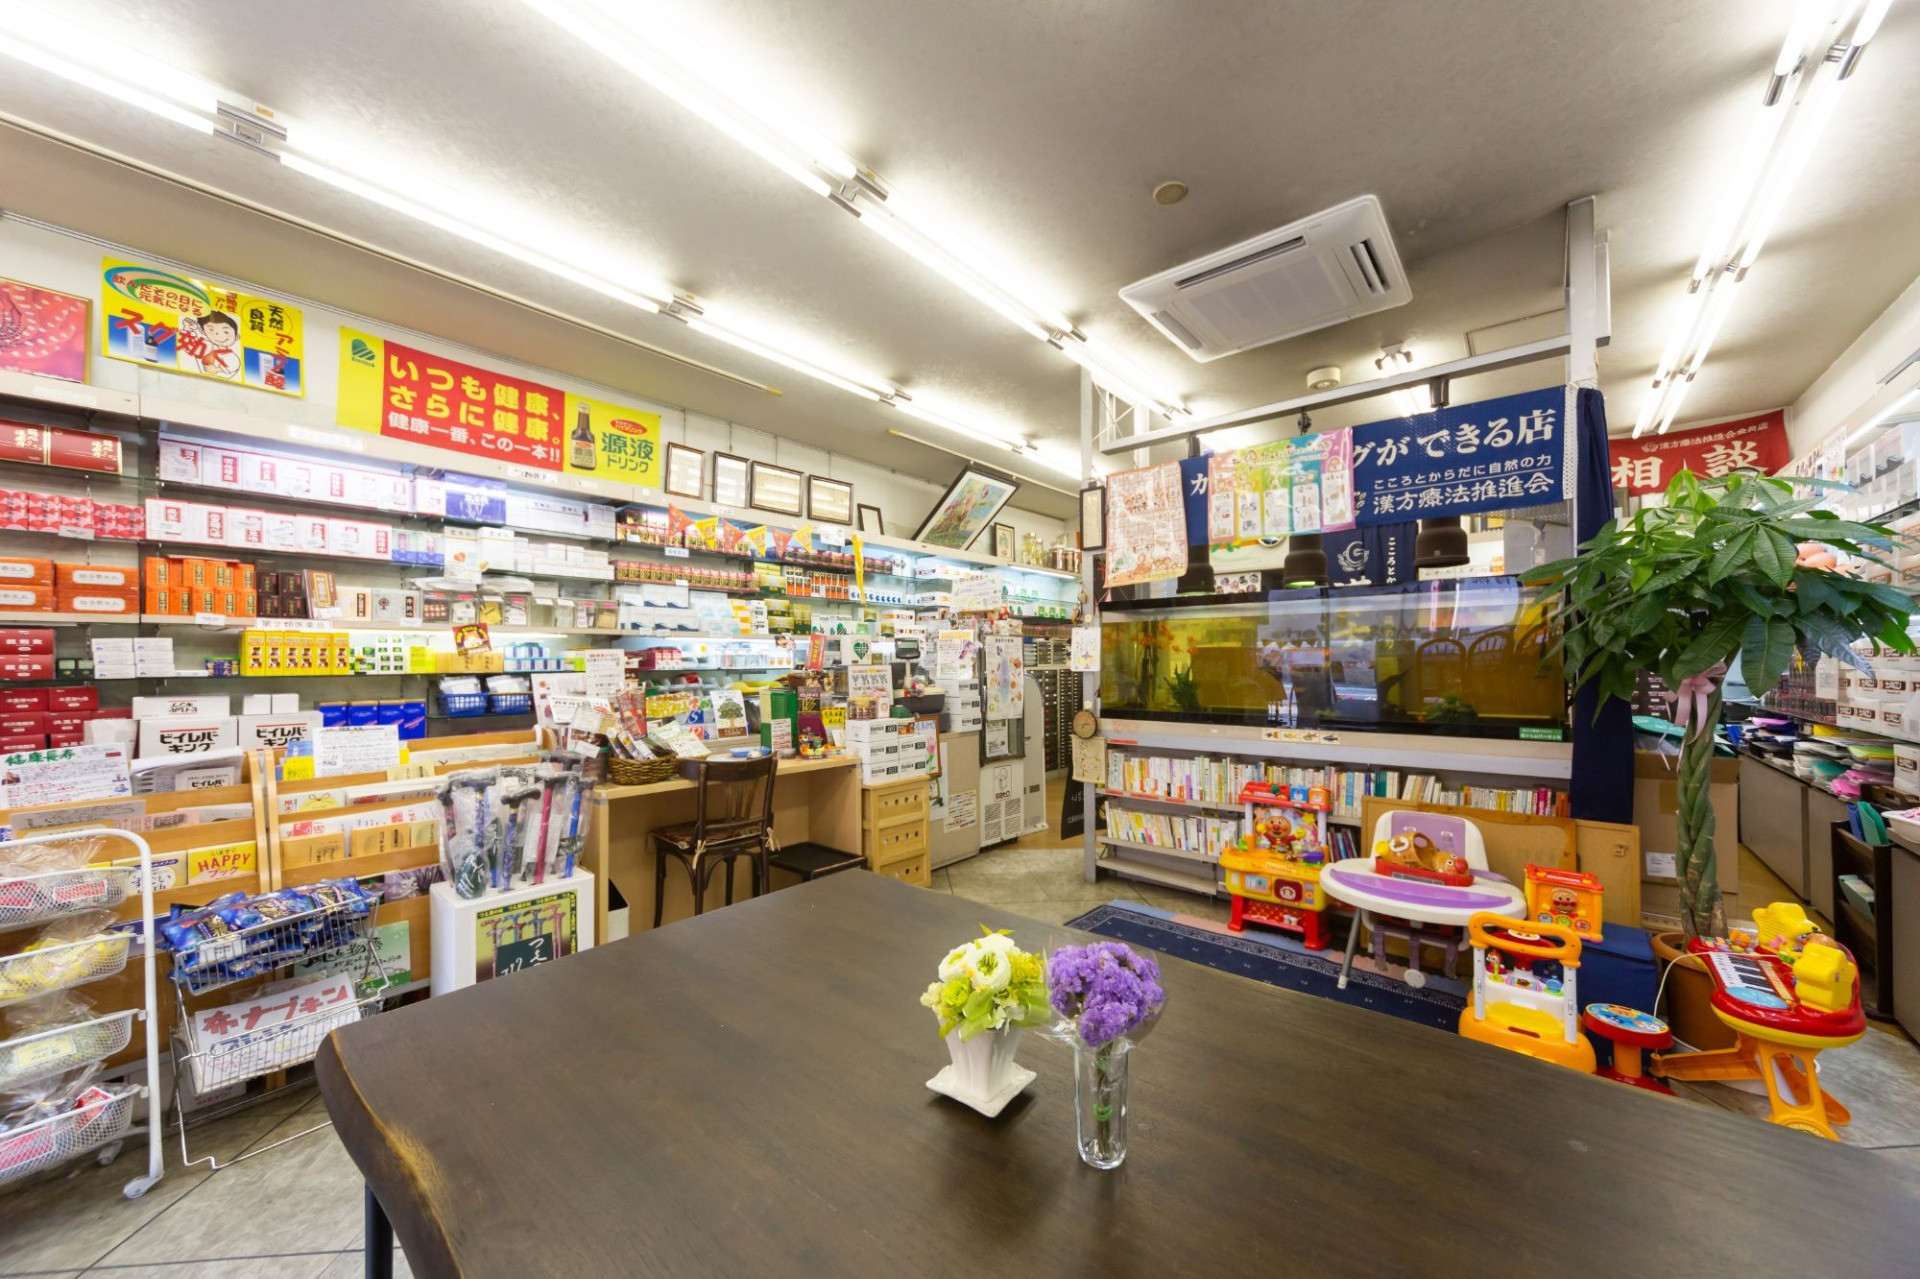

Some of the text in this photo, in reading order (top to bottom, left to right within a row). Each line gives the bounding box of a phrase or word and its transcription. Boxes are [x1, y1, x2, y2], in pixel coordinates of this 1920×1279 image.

[111, 273, 203, 309] 飲んだその日に
[139, 290, 203, 317] 元気になる
[269, 304, 284, 331] 天然
[115, 308, 233, 368] スグ効く
[265, 332, 294, 390] アミノ酸
[601, 432, 653, 461] 源液
[608, 455, 649, 473] ドリンク
[1374, 454, 1552, 490] こころとからだに自然の力
[1373, 472, 1554, 514] 漢方療法推進会
[160, 731, 219, 744] ビイレバー
[257, 727, 307, 738] ビイレバー
[169, 743, 215, 753] キング
[198, 853, 250, 872] HAPPY
